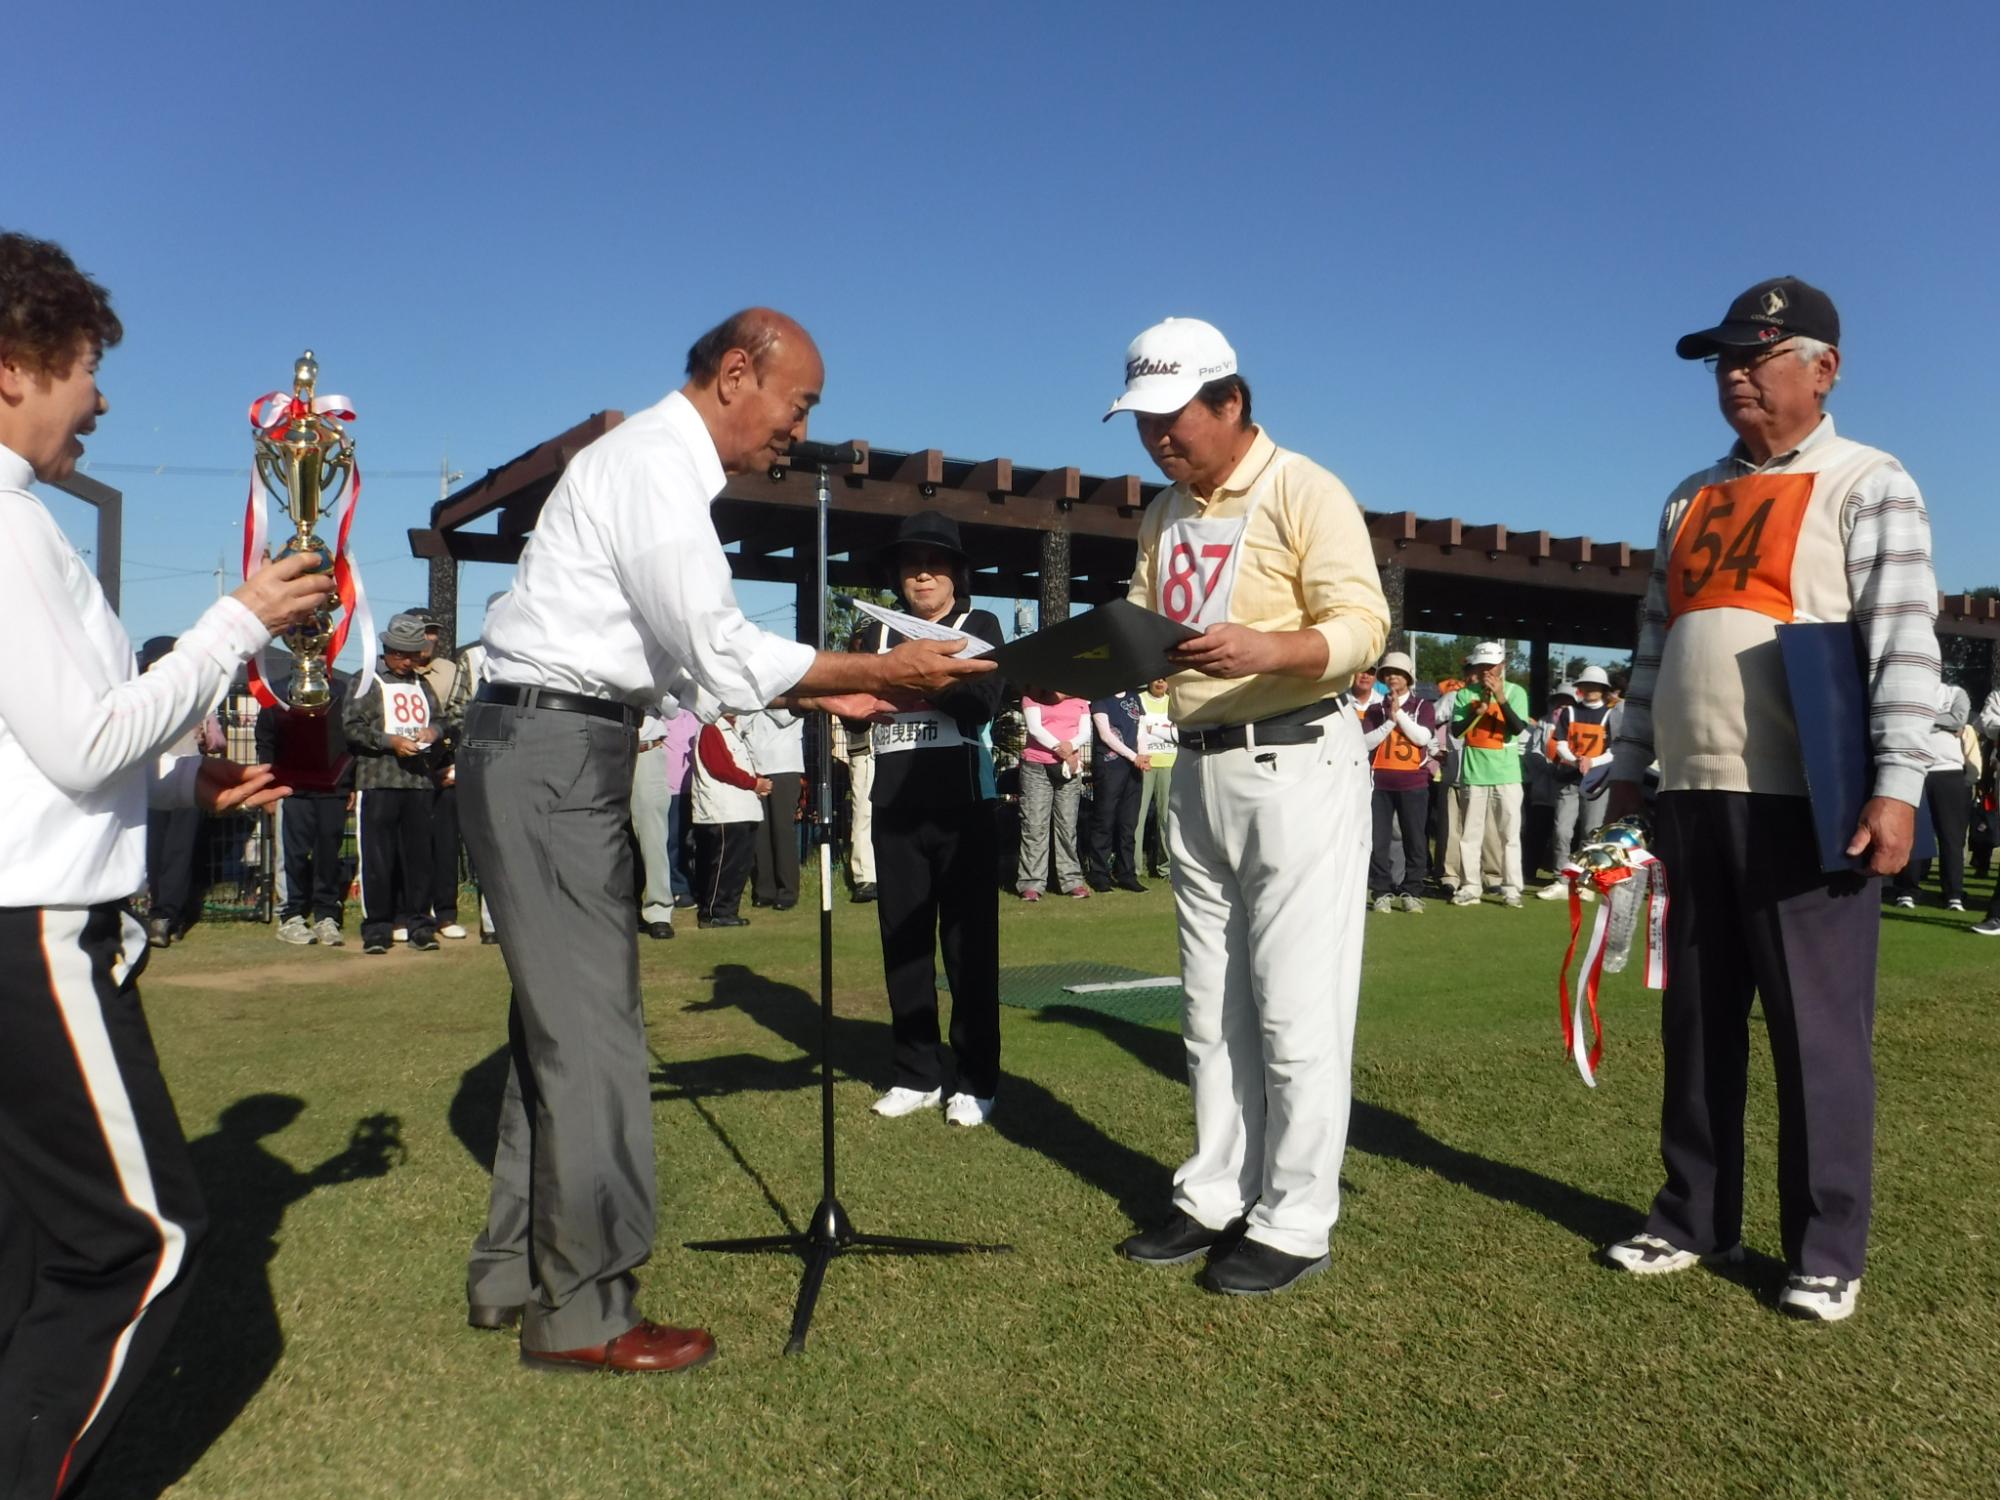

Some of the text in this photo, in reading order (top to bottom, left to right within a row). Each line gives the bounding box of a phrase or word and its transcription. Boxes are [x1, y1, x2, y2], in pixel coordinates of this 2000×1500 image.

[1682, 498, 1776, 598] 54
[1162, 542, 1234, 625] 87
[393, 692, 426, 724] 88
[1384, 733, 1413, 762] 15
